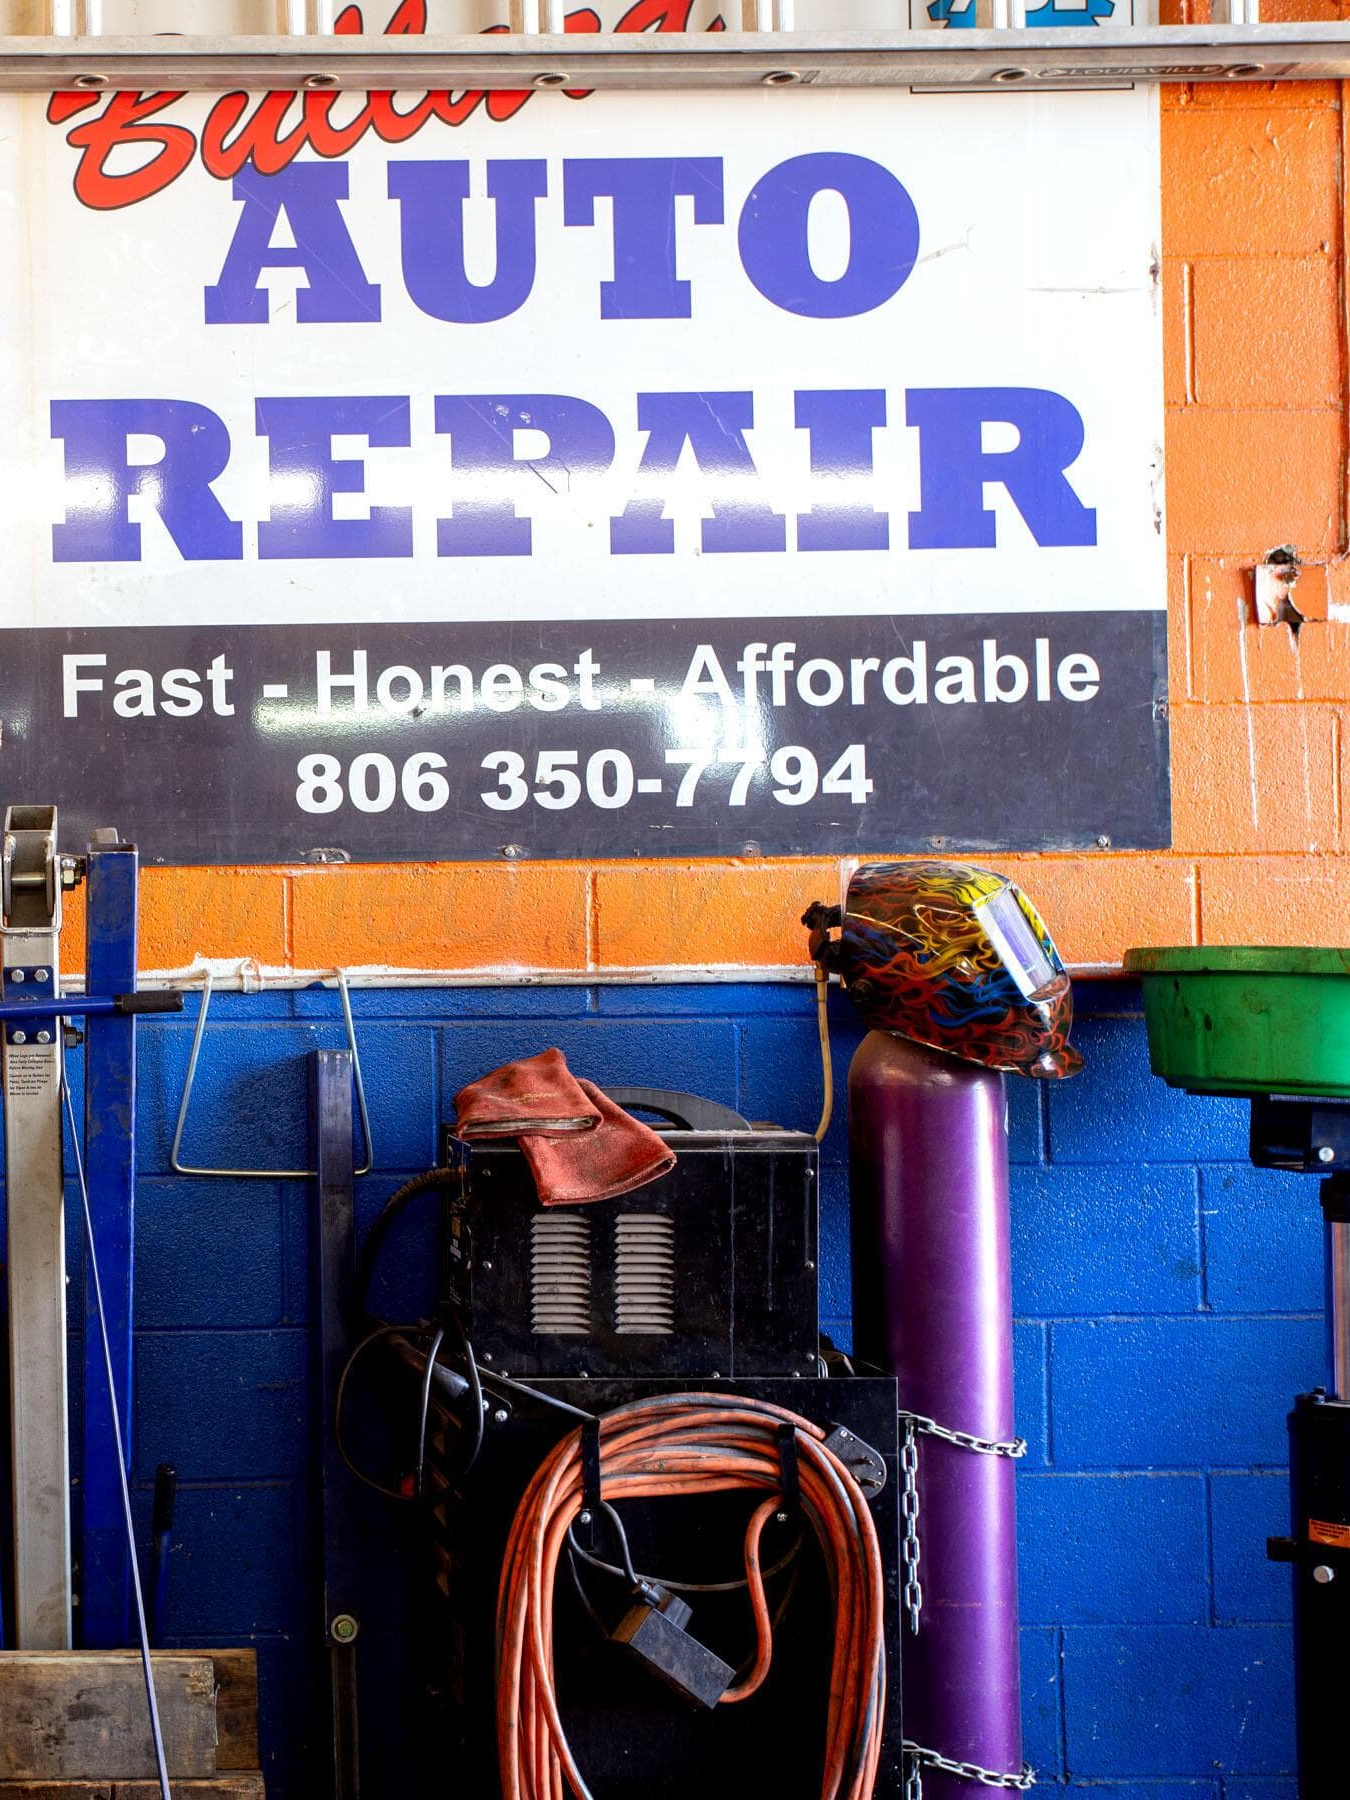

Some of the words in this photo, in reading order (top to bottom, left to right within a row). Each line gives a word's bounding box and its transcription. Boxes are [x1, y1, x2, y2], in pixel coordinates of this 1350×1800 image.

[1069, 65, 1224, 76] LOUISVILLE
[204, 151, 920, 324] AUTO
[49, 386, 1098, 562] REPAIR
[61, 652, 235, 718] Fast
[315, 647, 601, 716] Honest
[679, 638, 1101, 708] Affordable
[295, 751, 450, 813] 806
[480, 743, 874, 811] 350-7794
